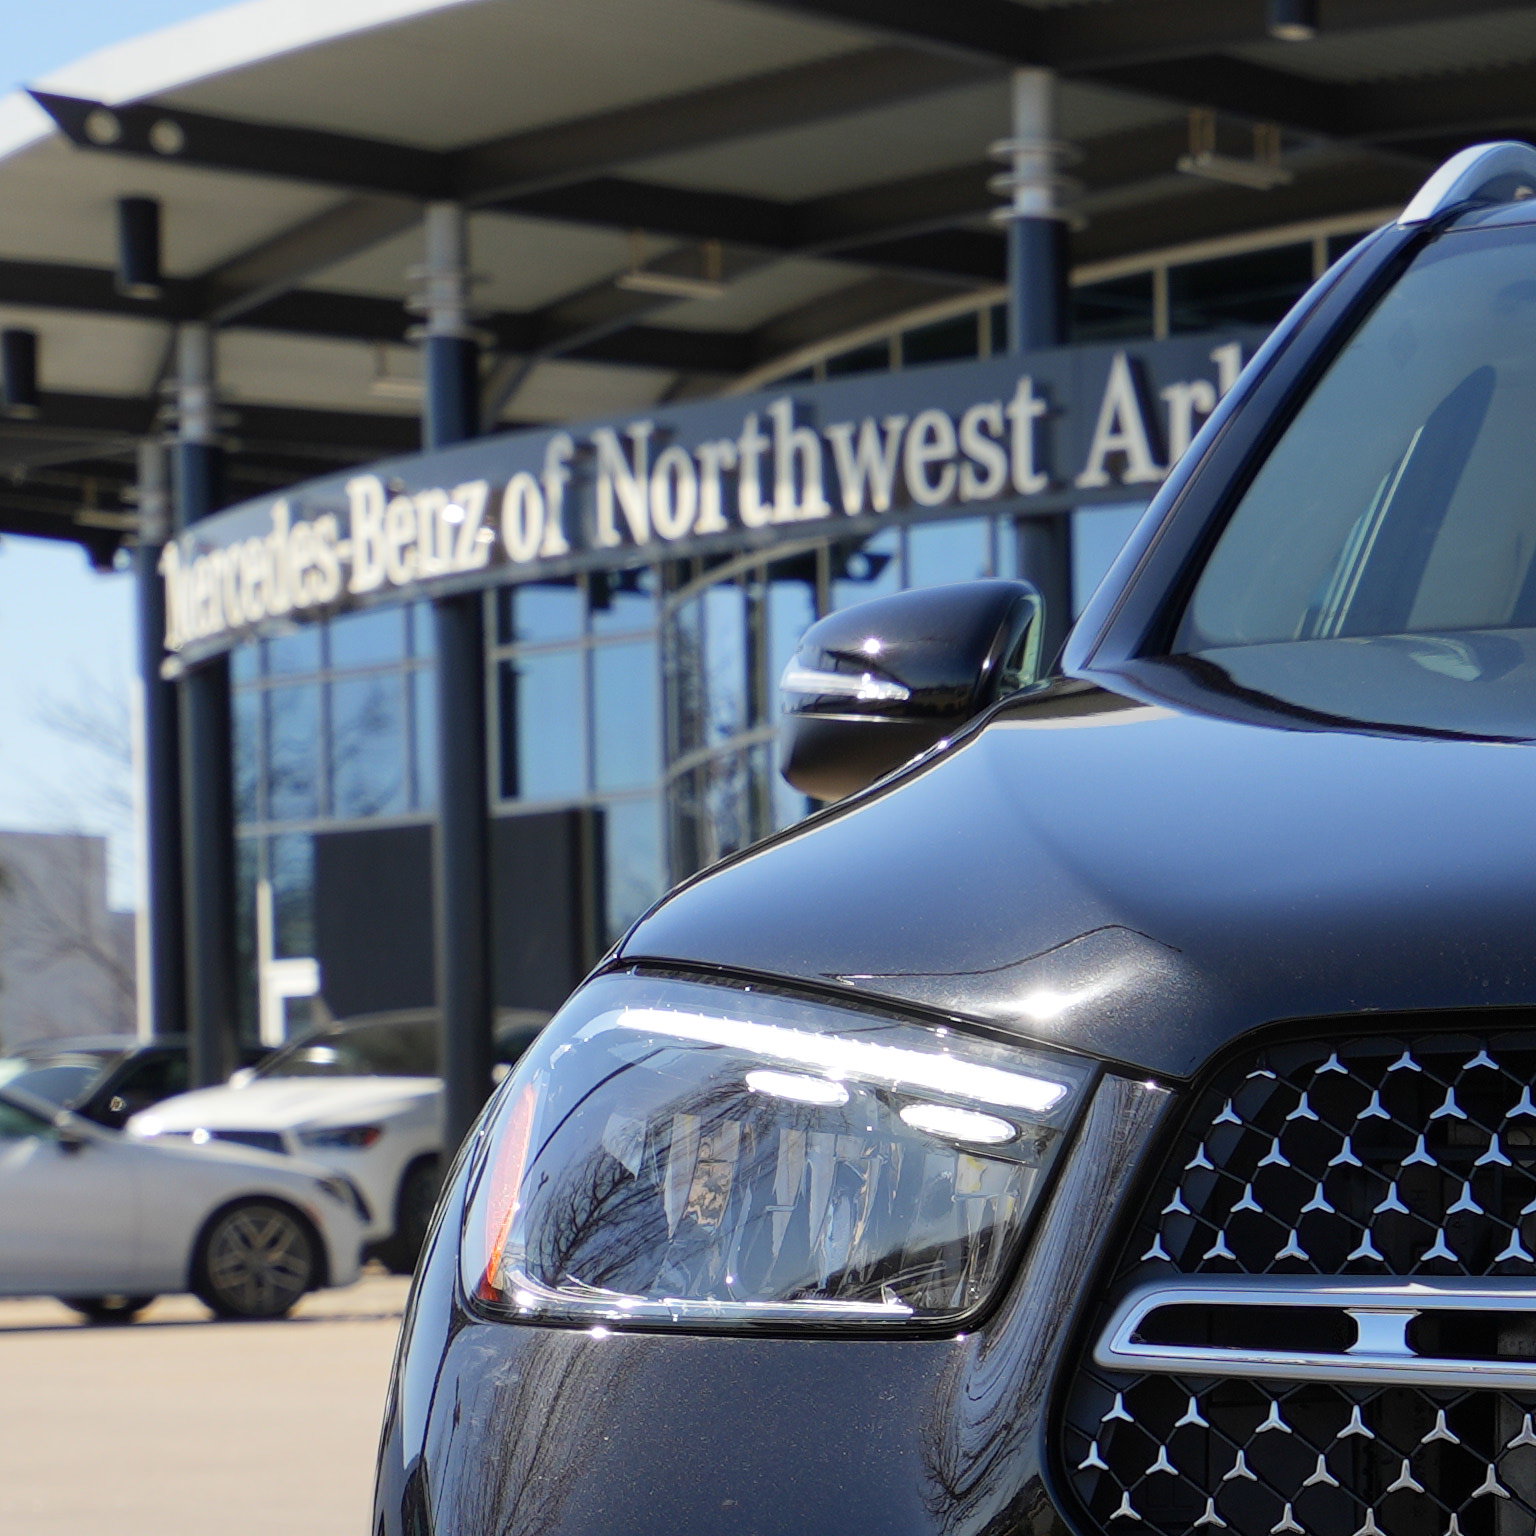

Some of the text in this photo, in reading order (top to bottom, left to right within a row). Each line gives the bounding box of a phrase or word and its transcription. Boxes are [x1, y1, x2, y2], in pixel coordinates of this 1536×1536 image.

[159, 474, 490, 650] Mercedes-Benz
[502, 433, 574, 563] of
[592, 373, 1048, 547] Northwest
